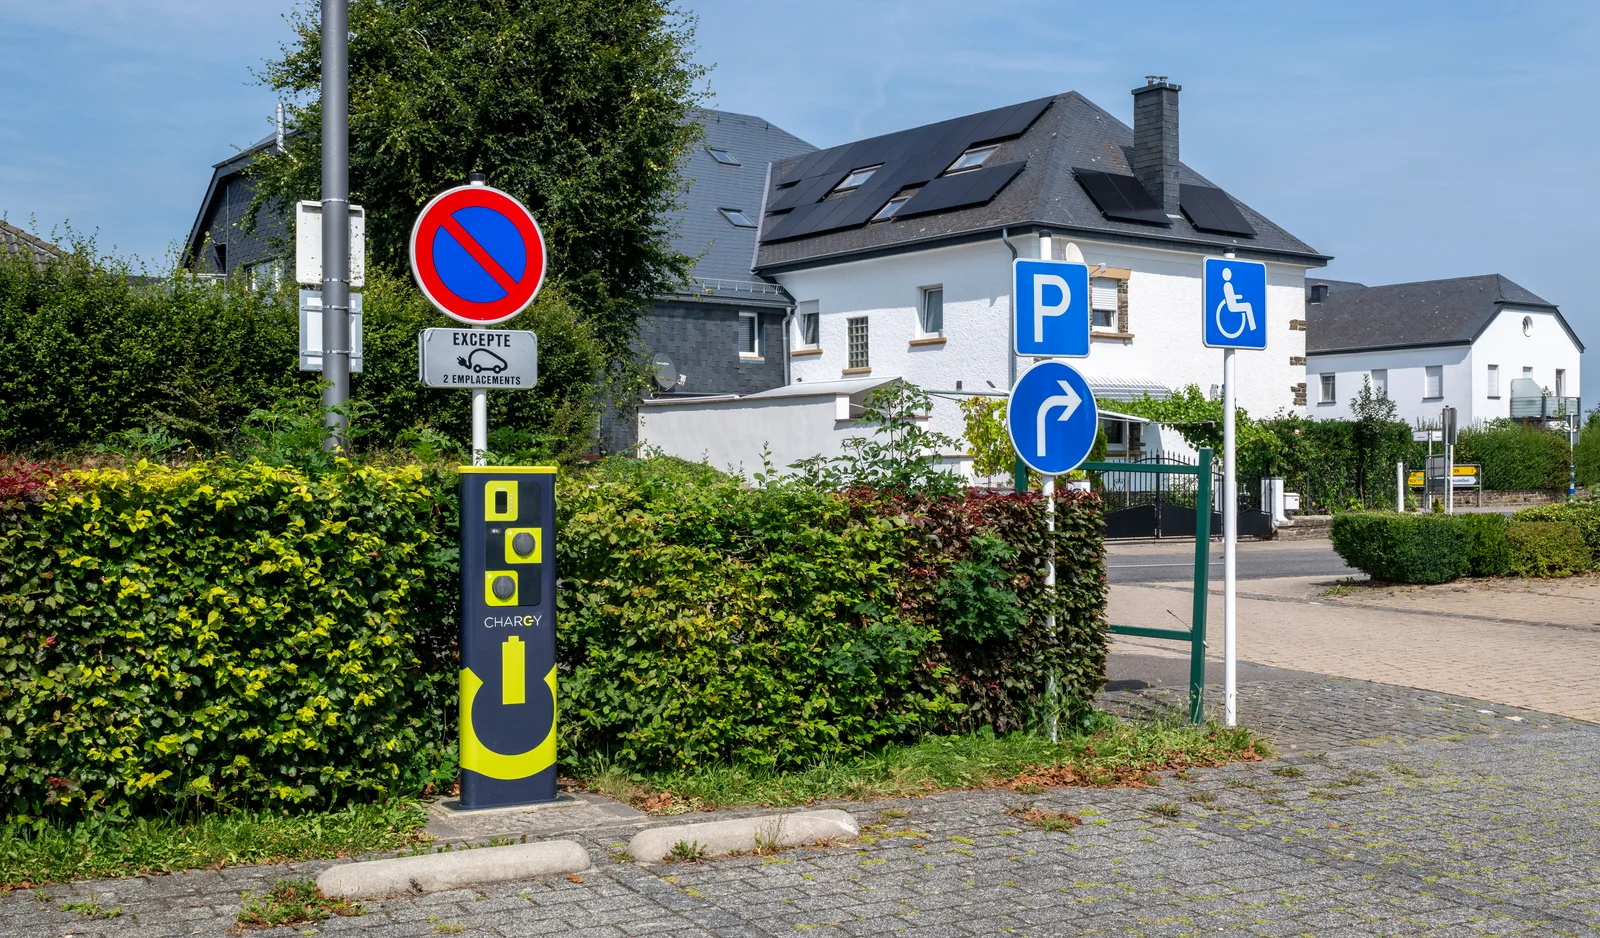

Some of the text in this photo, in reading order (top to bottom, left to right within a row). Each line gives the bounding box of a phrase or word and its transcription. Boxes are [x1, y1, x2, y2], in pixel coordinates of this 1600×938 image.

[1033, 273, 1071, 343] P
[453, 332, 511, 348] EXCEPTE
[443, 374, 521, 386] 2 EMPLACEMENTS
[484, 614, 543, 629] CHARGY
